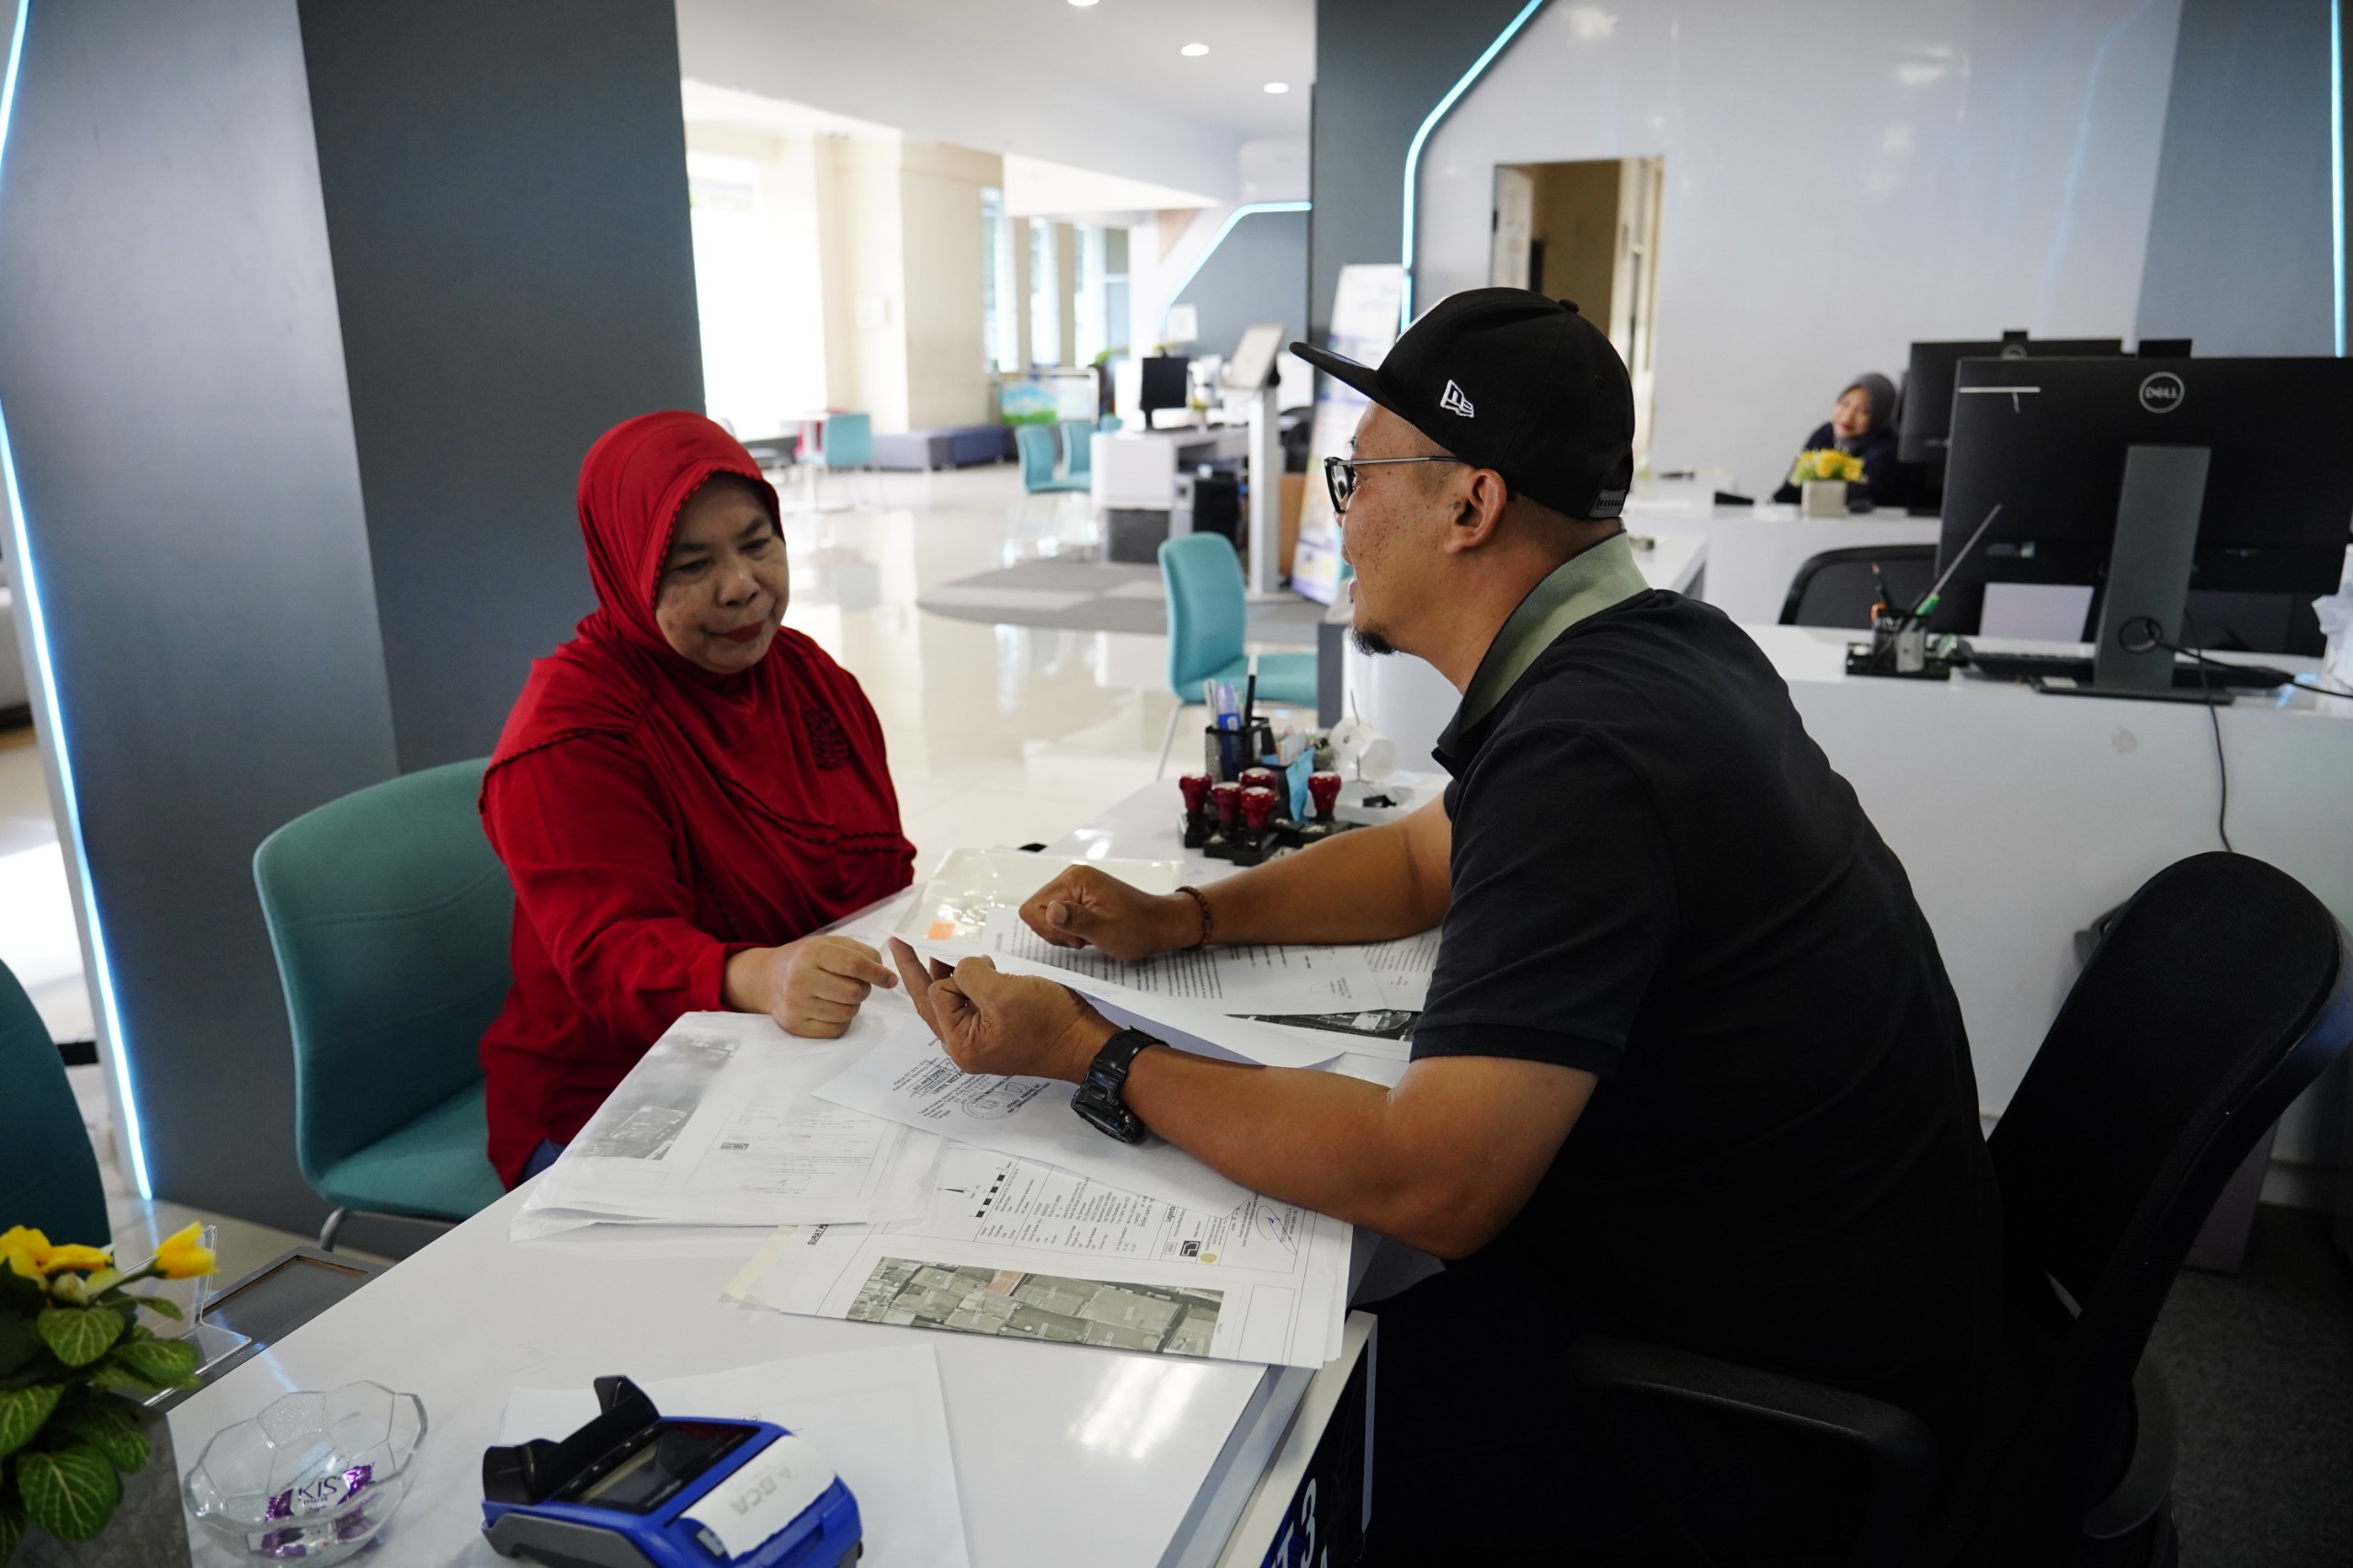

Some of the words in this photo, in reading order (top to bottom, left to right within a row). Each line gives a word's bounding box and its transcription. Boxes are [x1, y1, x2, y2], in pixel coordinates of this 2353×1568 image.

[2145, 387, 2177, 399] DELL
[299, 1476, 336, 1501] KIS
[730, 1480, 777, 1515] BCA
